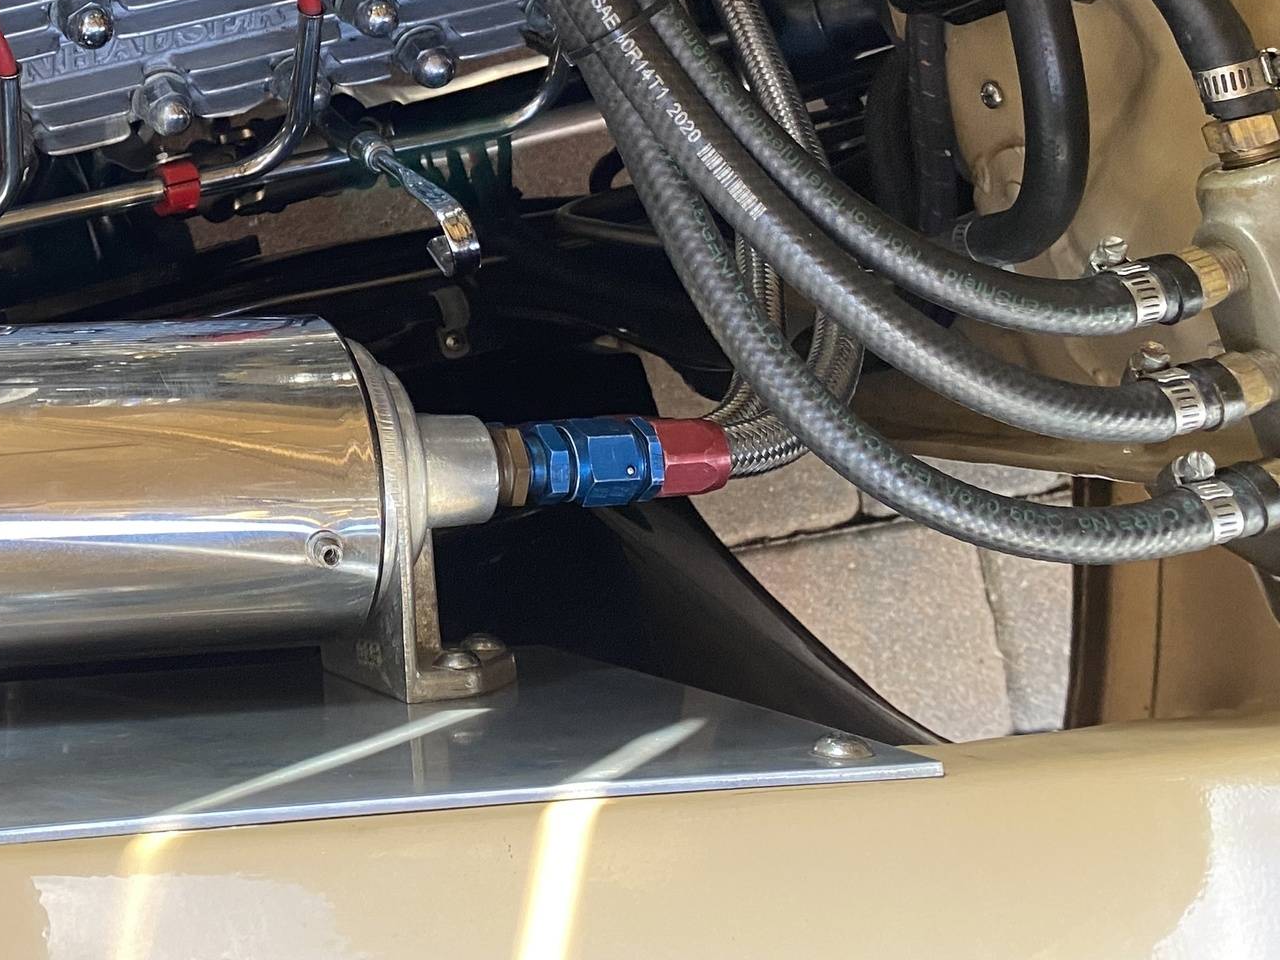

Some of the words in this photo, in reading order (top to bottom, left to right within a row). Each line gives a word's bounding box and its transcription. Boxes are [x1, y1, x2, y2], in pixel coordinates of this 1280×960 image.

[670, 17, 735, 98] Systems
[666, 102, 702, 143] 2020
[732, 95, 806, 171] Injection
[799, 167, 847, 211] Fuel
[841, 202, 882, 238] For
[882, 229, 924, 263] Not
